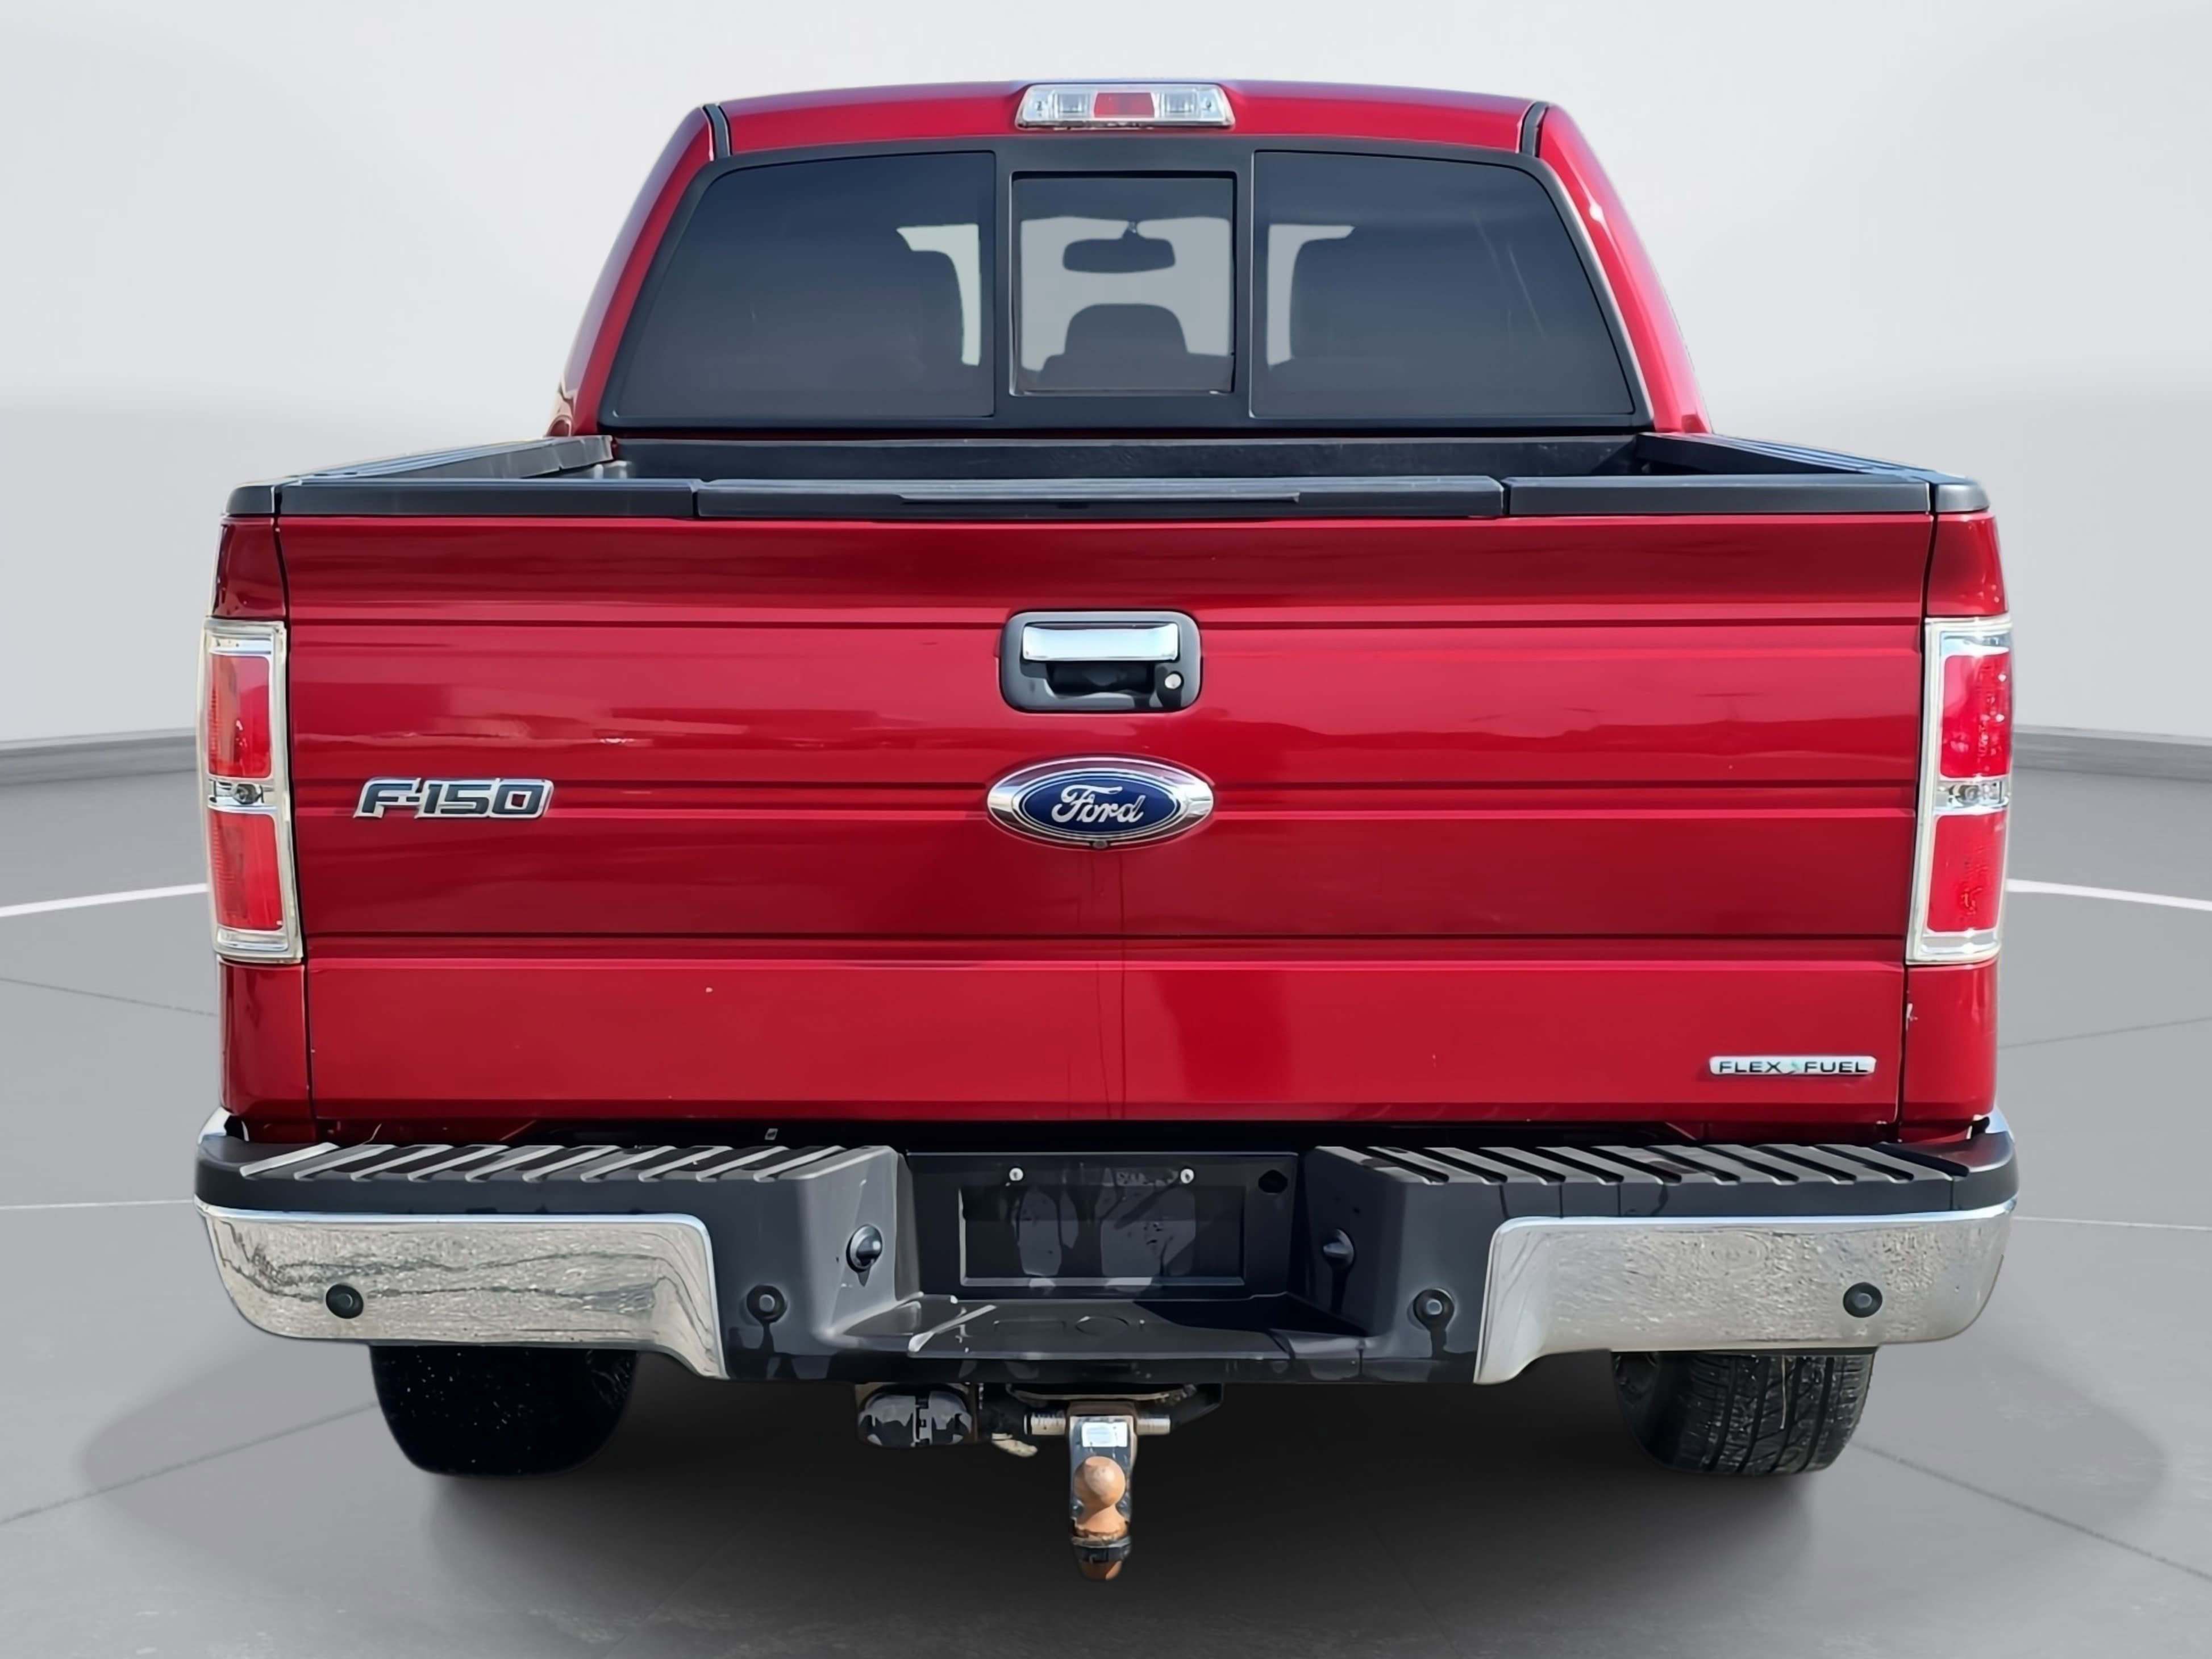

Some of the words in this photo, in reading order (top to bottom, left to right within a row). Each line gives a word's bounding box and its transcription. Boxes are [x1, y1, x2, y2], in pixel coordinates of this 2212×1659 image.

[353, 778, 554, 818] F-150
[1051, 785, 1145, 823] Ford
[1719, 1061, 1782, 1073] FLEX
[1804, 1061, 1869, 1073] FUEL
